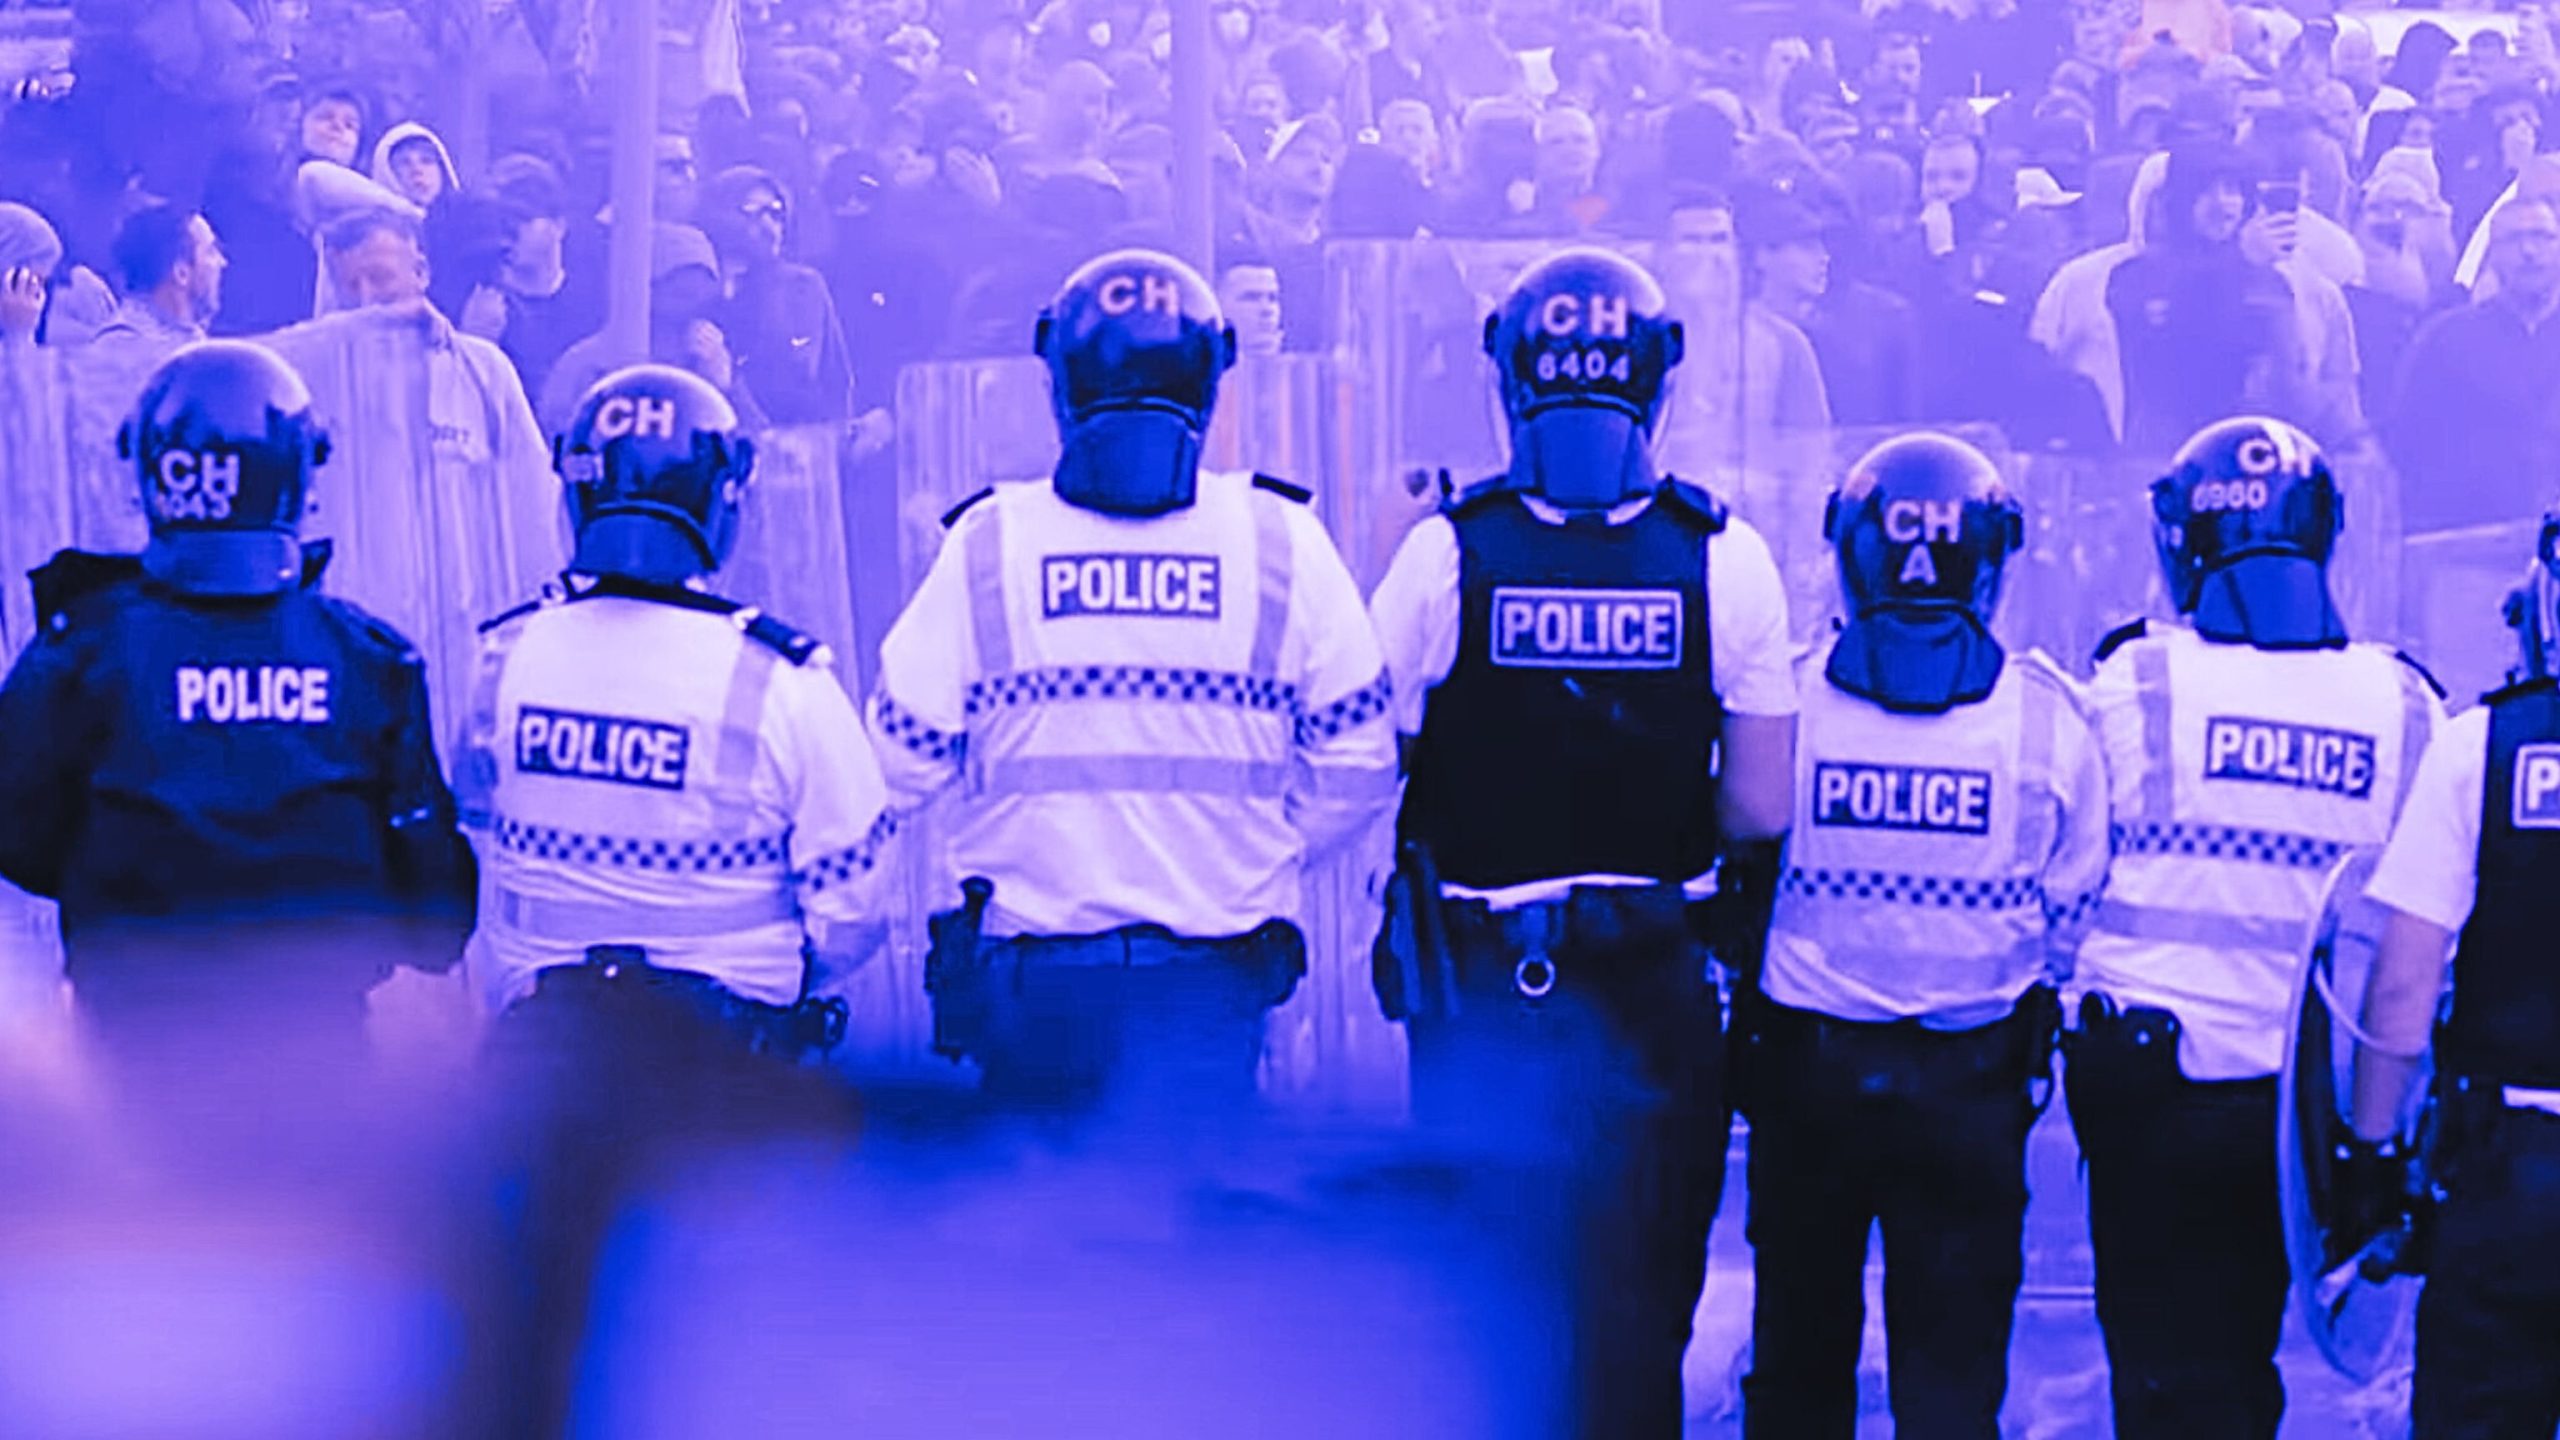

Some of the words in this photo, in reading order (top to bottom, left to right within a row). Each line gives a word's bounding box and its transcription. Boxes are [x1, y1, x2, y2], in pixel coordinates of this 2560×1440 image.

[1099, 275, 1180, 317] CH
[1542, 293, 1628, 339] CH
[597, 396, 675, 439] CH
[160, 449, 240, 496] CH
[2238, 437, 2312, 478] CH
[1884, 499, 1962, 543] CH
[1046, 558, 1216, 613] POLICE
[1899, 543, 1938, 585] A
[1502, 600, 1672, 655] POLICE
[176, 665, 329, 723] POLICE
[521, 714, 683, 784] POLICE
[2209, 722, 2371, 790] POLICE
[1818, 767, 1987, 828] POLICE
